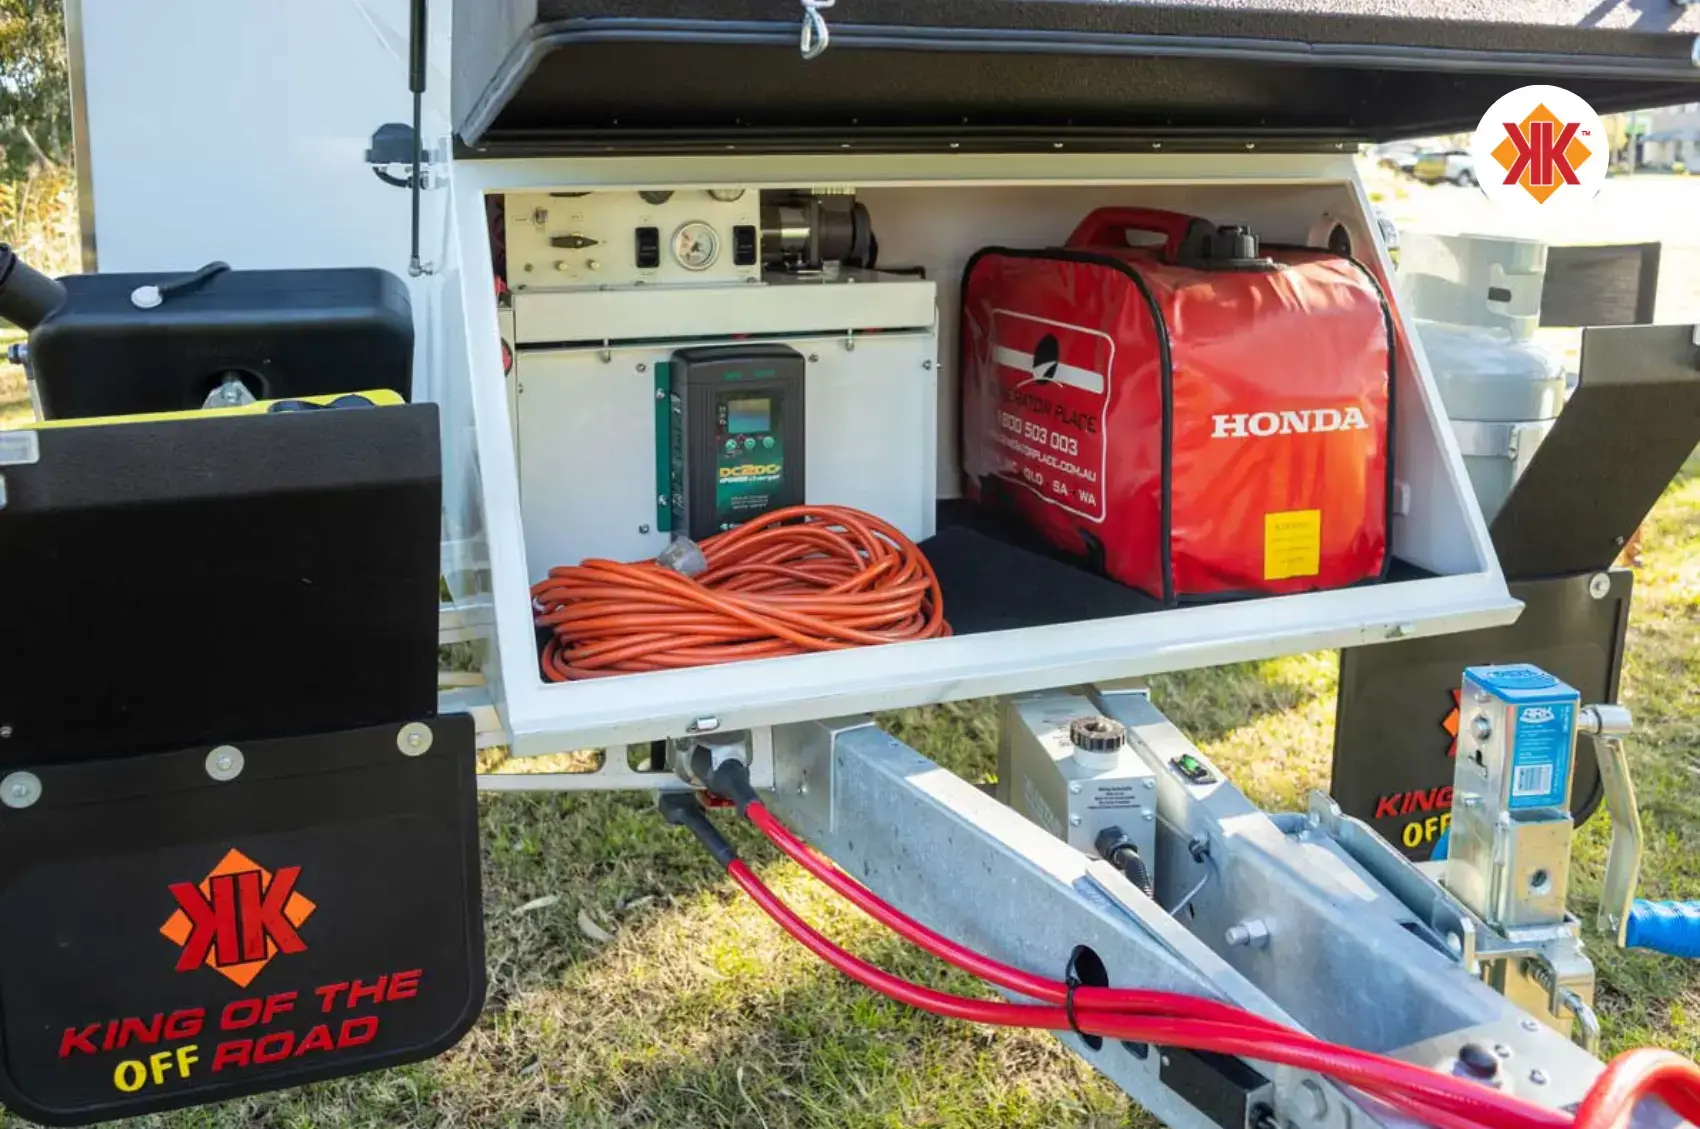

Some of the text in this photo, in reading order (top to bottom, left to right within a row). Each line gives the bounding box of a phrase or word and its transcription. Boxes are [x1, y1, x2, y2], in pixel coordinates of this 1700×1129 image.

[1054, 405, 1097, 433] PLACE
[1211, 406, 1369, 439] HONDA
[1024, 421, 1048, 445] 503
[1051, 431, 1078, 456] 003
[1023, 467, 1044, 486] QLD
[1052, 479, 1068, 497] SA
[1078, 488, 1097, 507] WA
[1375, 785, 1454, 820] KING
[57, 968, 423, 1059] KING OF THE
[113, 1016, 380, 1093] OFF ROAD
